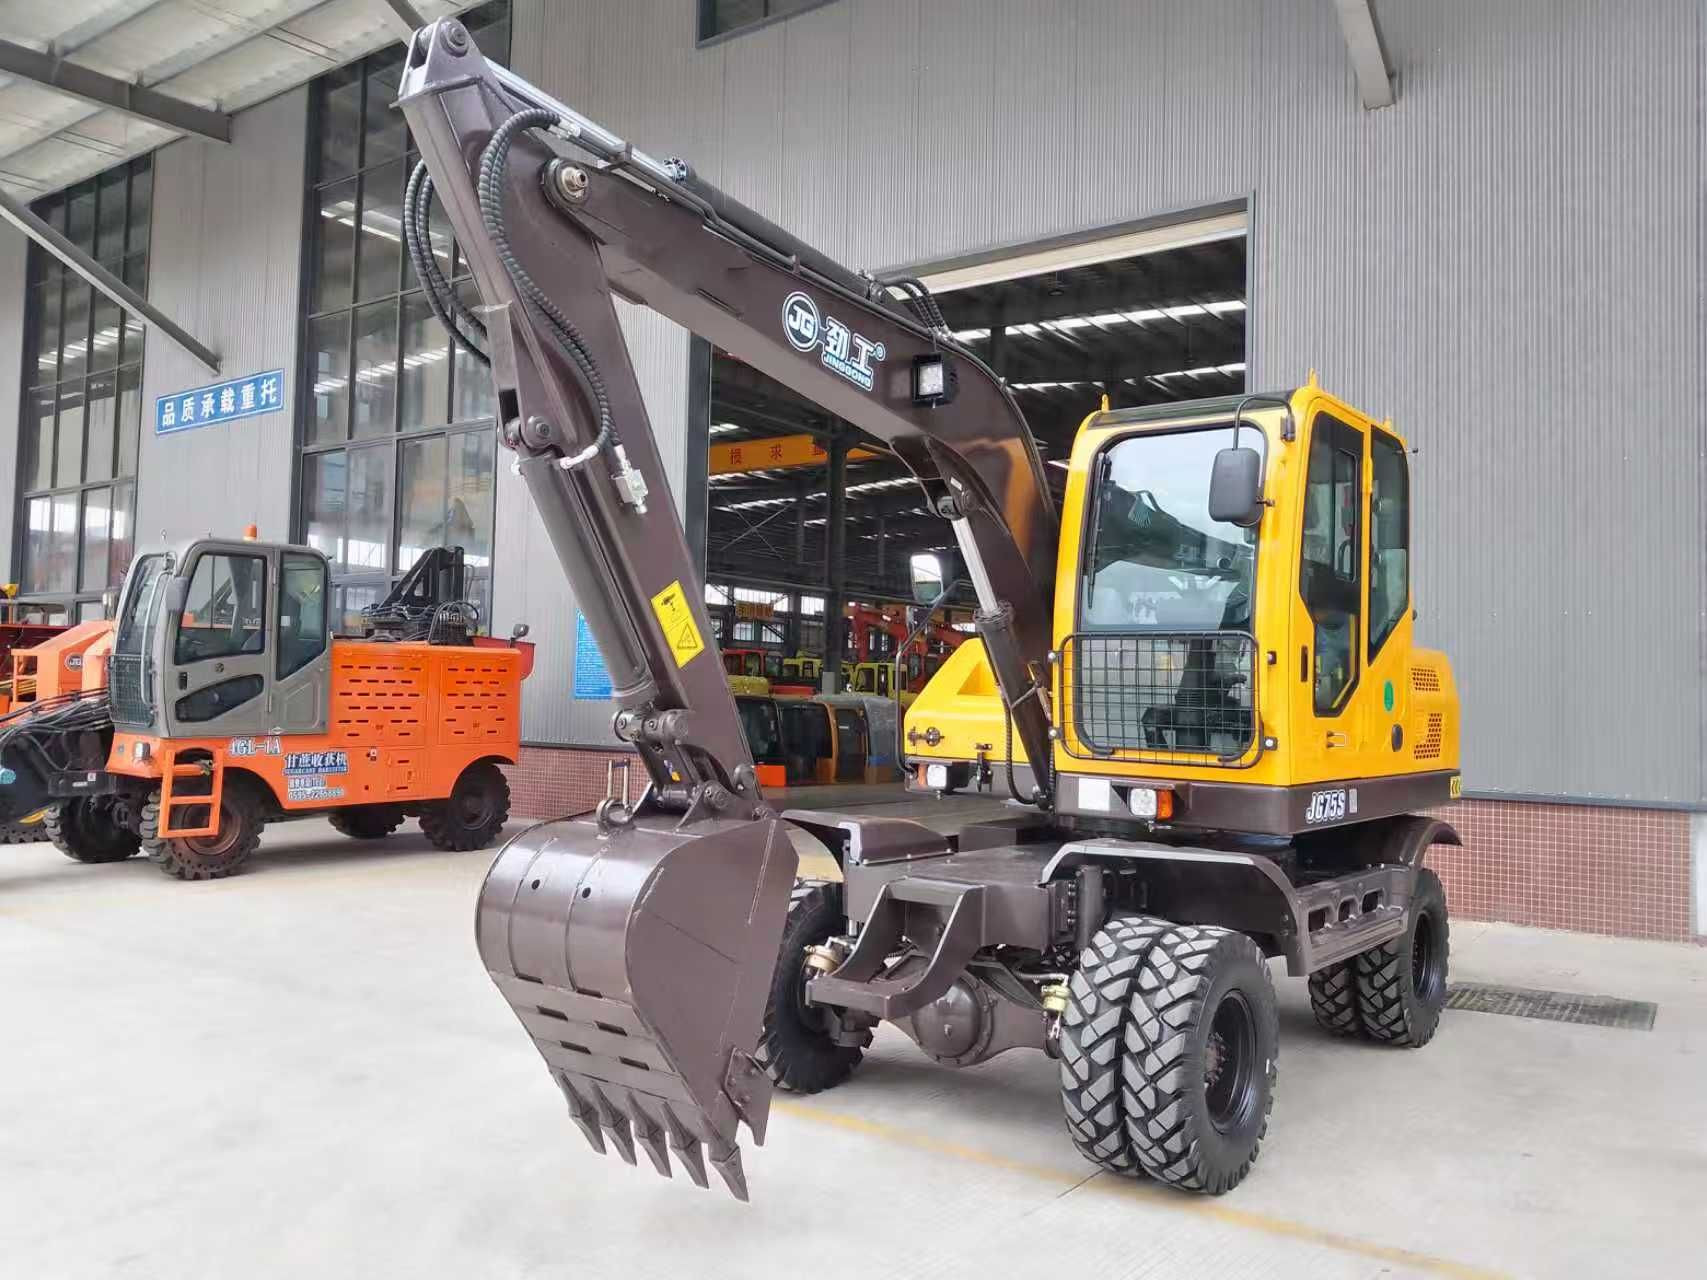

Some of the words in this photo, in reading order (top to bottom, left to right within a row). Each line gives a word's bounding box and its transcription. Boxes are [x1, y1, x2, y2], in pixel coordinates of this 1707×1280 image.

[788, 304, 815, 339] JG
[824, 319, 875, 377] 劲工
[161, 377, 277, 427] 品质承载重托
[1305, 790, 1346, 823] JG75S
